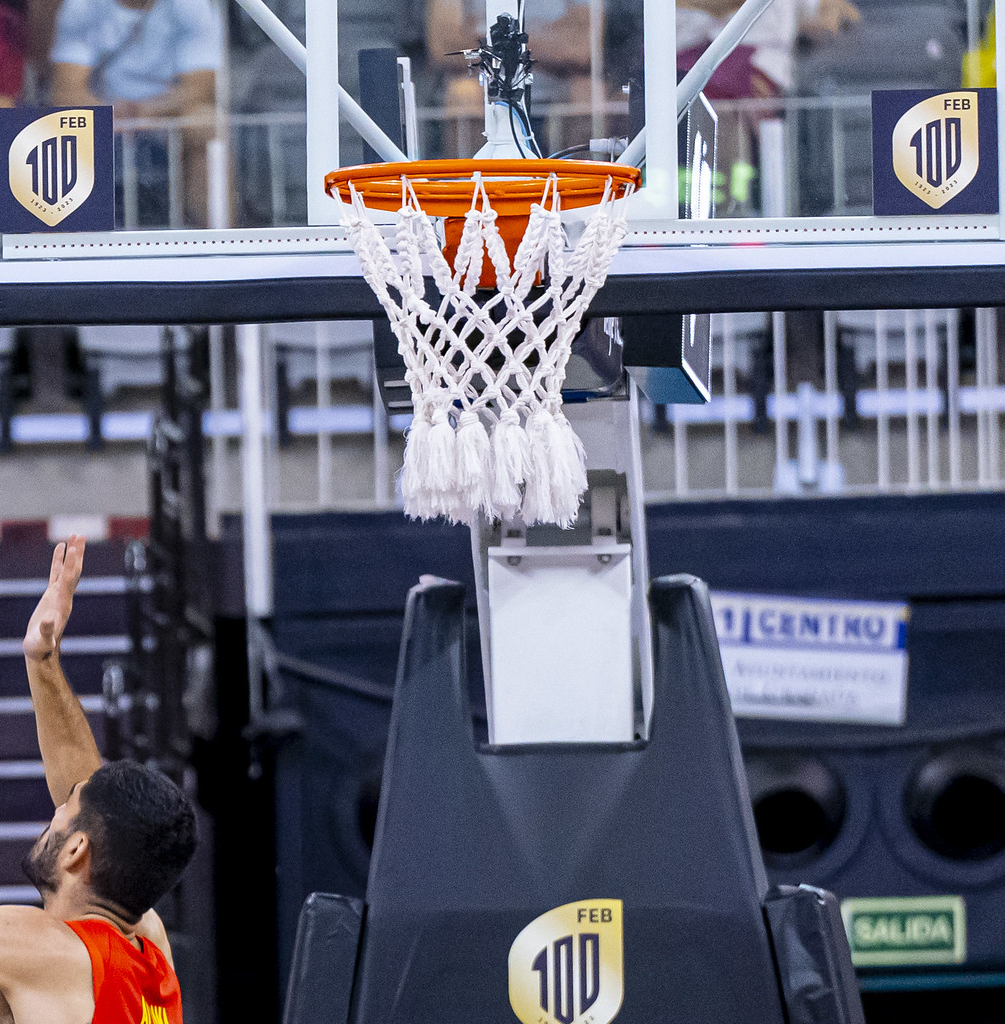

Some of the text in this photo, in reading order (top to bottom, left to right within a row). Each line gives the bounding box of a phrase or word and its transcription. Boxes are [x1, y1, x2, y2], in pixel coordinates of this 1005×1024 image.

[943, 98, 971, 111] FEB
[60, 116, 87, 128] FEB
[909, 117, 962, 188] 100
[25, 135, 78, 206] 100
[576, 908, 613, 924] FEB
[855, 915, 951, 942] SALIDA
